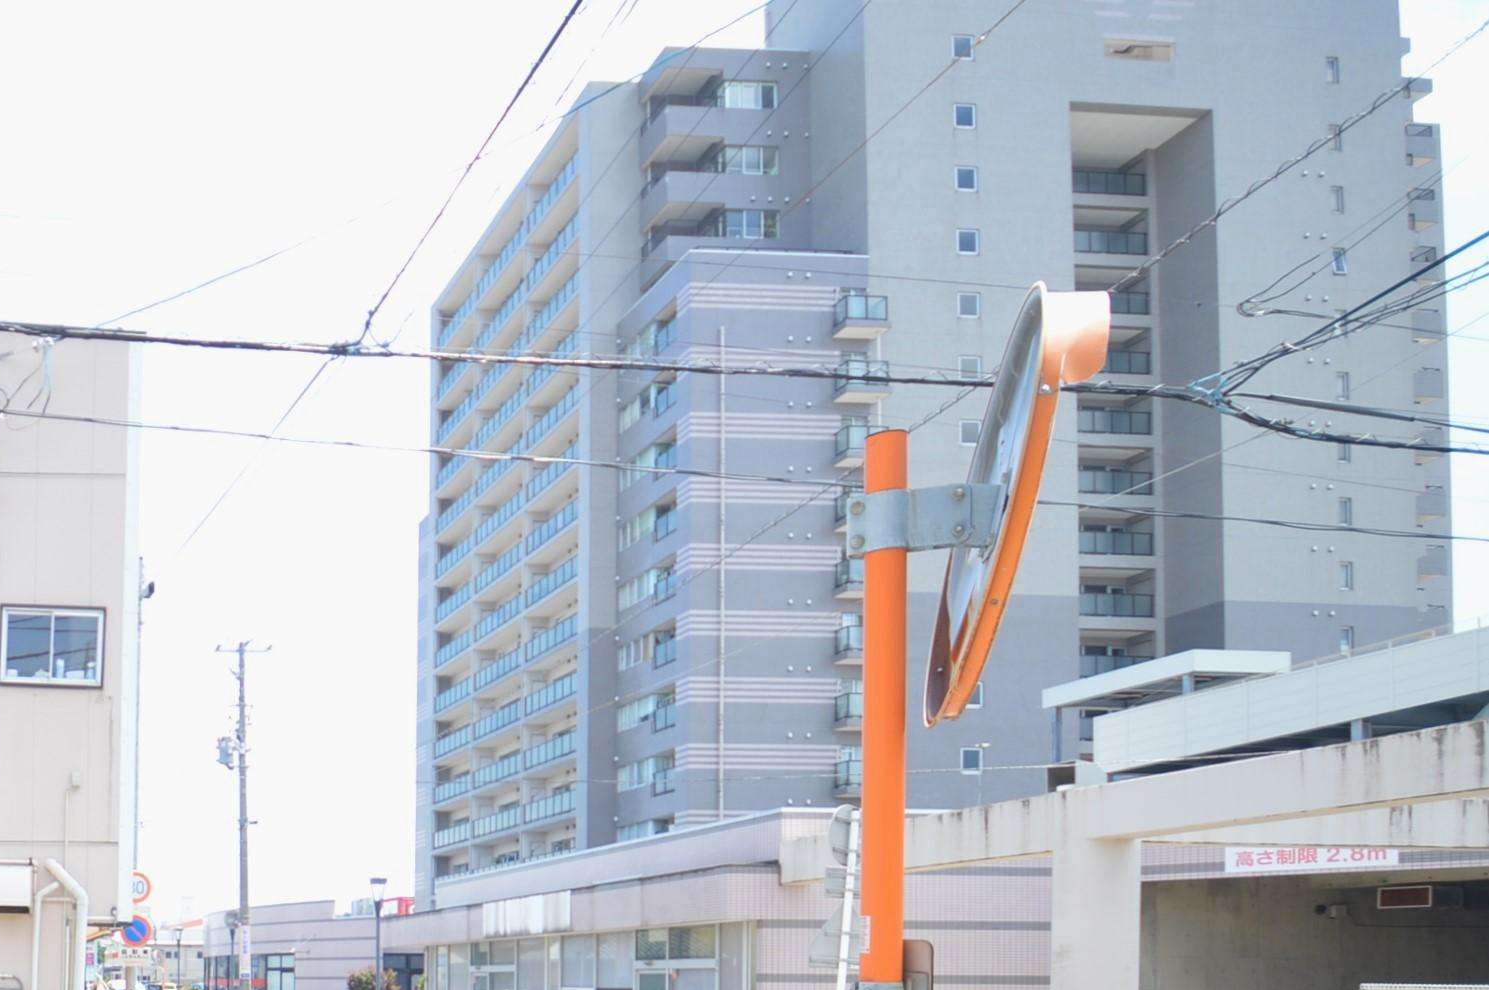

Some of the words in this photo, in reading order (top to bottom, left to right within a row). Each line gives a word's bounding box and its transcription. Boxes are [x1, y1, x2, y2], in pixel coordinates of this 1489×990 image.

[1235, 847, 1318, 867] 高さ制限
[1326, 847, 1388, 864] 2.8m
[133, 880, 145, 895] 0
